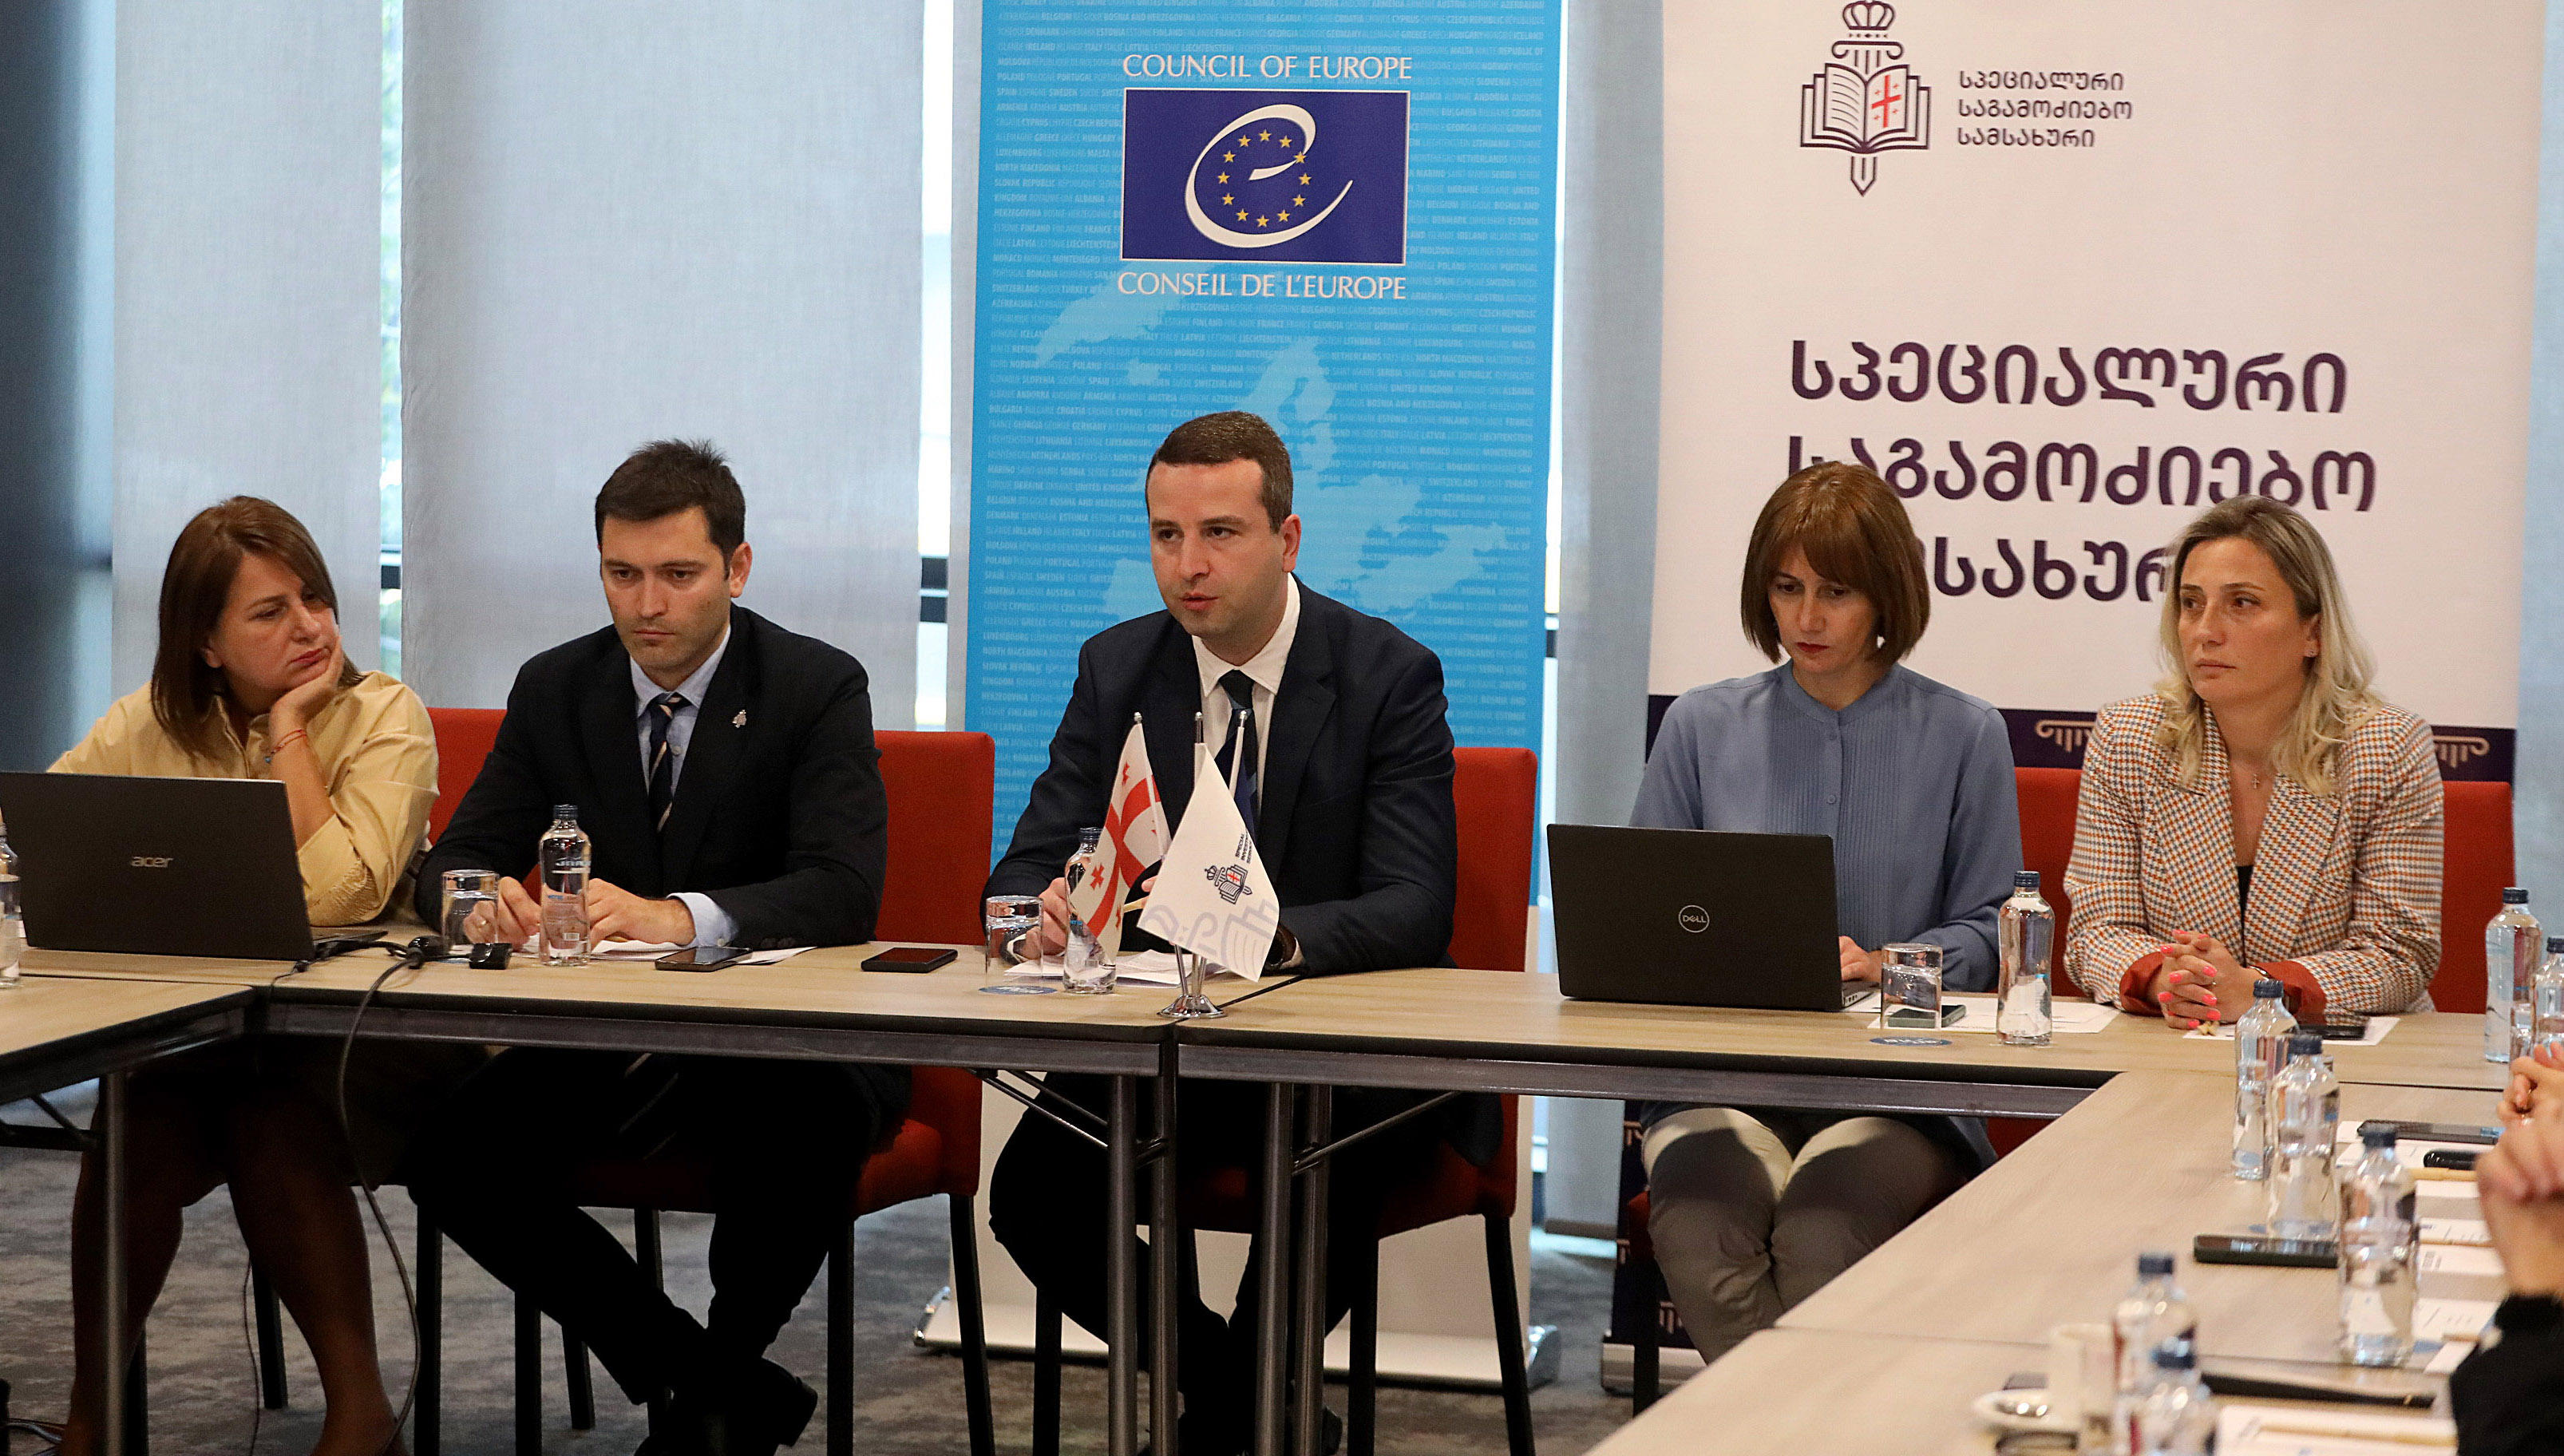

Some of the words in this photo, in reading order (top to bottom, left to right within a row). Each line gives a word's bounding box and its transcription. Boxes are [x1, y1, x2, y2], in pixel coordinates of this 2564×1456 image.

[1122, 54, 1252, 77] COUNCIL
[1260, 55, 1298, 78] OF
[1308, 56, 1412, 79] EUROPE
[1959, 70, 2124, 91] სპეციალური
[1958, 98, 2132, 120] საგამოძიებო
[1957, 127, 2095, 148] სამსახური
[1117, 271, 1233, 296] CONSEIL
[1240, 274, 1276, 297] DE
[1790, 338, 2348, 413] სპეციალური
[1917, 535, 2173, 603] სახურ
[131, 856, 173, 868] acer
